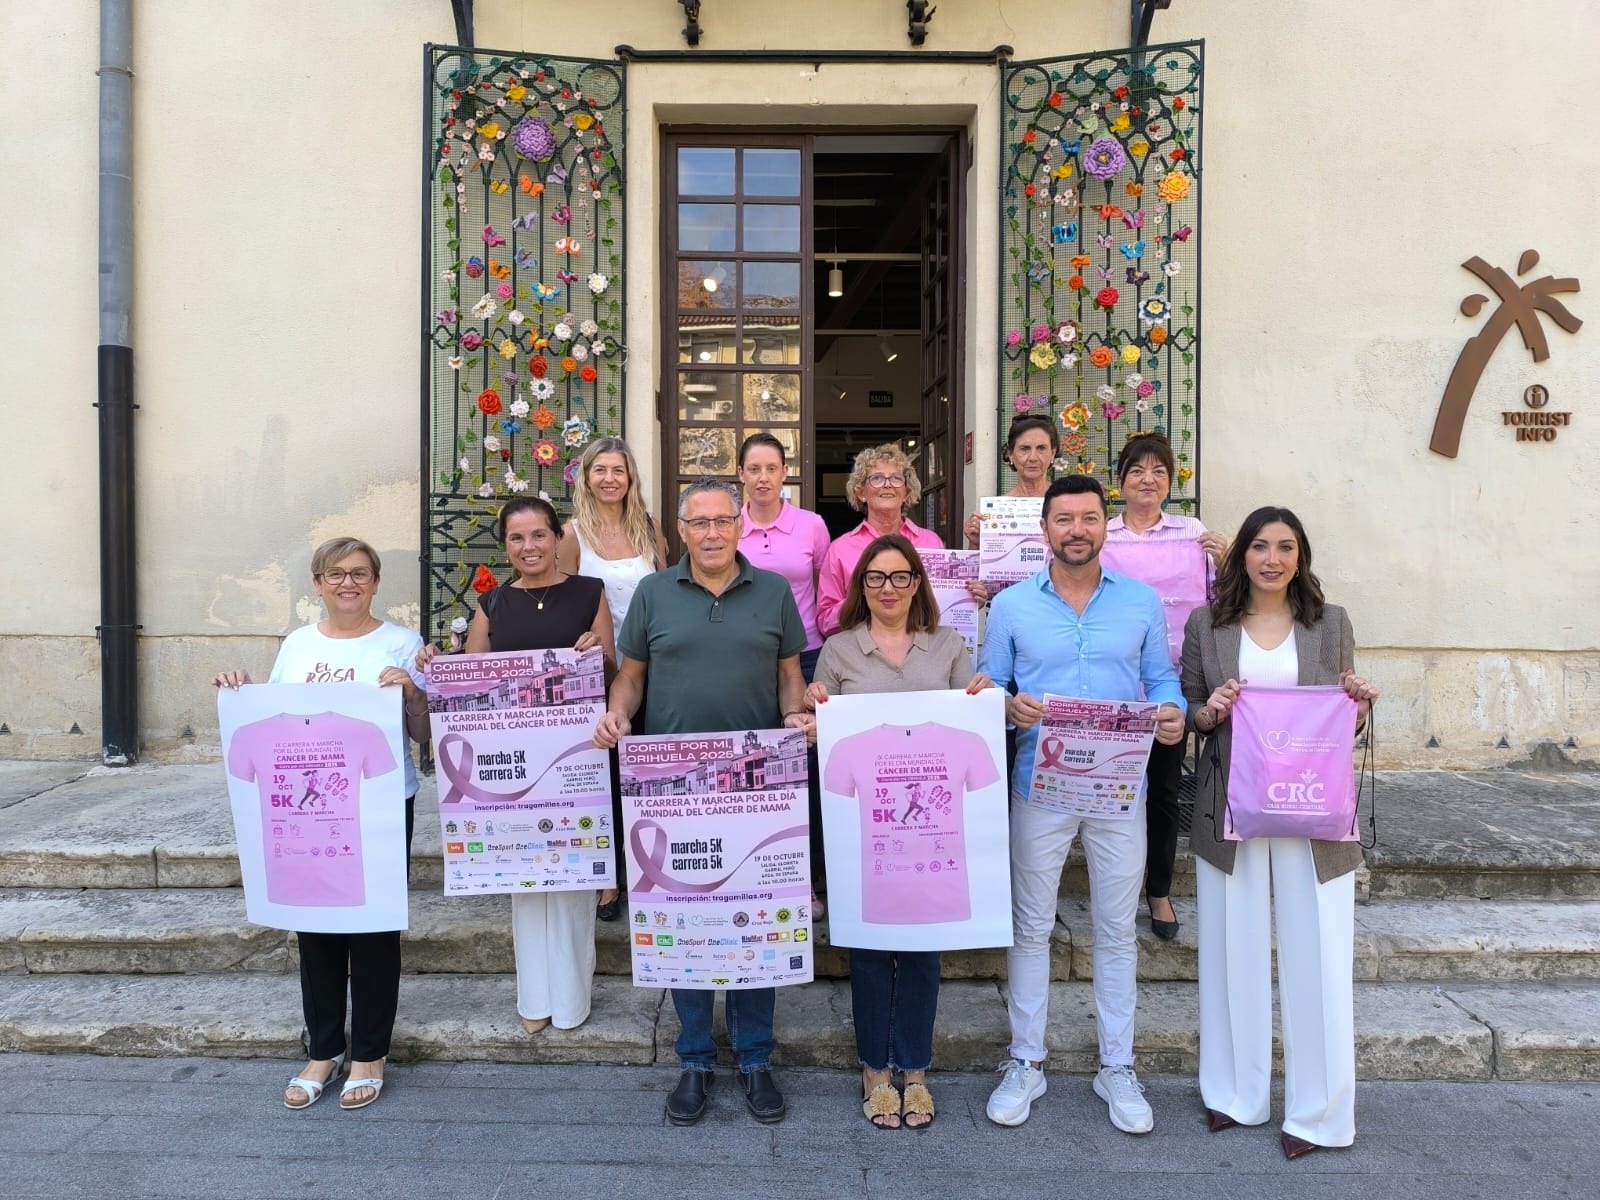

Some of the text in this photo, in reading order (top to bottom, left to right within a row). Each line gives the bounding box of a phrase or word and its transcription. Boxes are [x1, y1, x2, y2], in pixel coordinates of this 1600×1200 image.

[1502, 412, 1572, 426] TOURIST
[1516, 428, 1558, 442] INFO
[316, 662, 331, 673] EL
[433, 662, 478, 672] CORRE
[482, 659, 510, 669] POR
[306, 668, 354, 683] ROSA
[432, 668, 534, 682] ORIHUELA 2025
[441, 715, 450, 723] IX
[452, 713, 494, 722] CARRERA
[504, 710, 544, 720] MARCHA
[546, 708, 565, 717] POR
[579, 704, 595, 715] DÍA
[448, 716, 590, 732] MUNDIAL DEL CÁNCER DE MAMA
[628, 743, 676, 753] CORRE
[680, 741, 708, 750] POR
[477, 750, 526, 766] marcha 5K
[626, 750, 734, 763] ORIHUELA 2025
[273, 774, 285, 784] 19
[479, 765, 527, 781] carrera 5k
[646, 798, 690, 807] CARRERA
[701, 795, 743, 805] MARCHA
[746, 794, 766, 802] POR
[768, 793, 778, 801] EL
[780, 790, 796, 800] DÍA
[875, 788, 888, 798] 19
[1268, 782, 1325, 803] CRC
[271, 794, 294, 808] 5K
[518, 801, 574, 810] tragamillas.org
[640, 803, 791, 818] MUNDIAL DEL CÁNCER DE MAMA
[873, 809, 897, 823] 5K
[671, 838, 723, 854] marcha 5K
[672, 854, 723, 870] carrera 5k
[774, 852, 804, 860] OCTUBRE
[666, 892, 772, 903] Inscripción: tragamillas.org
